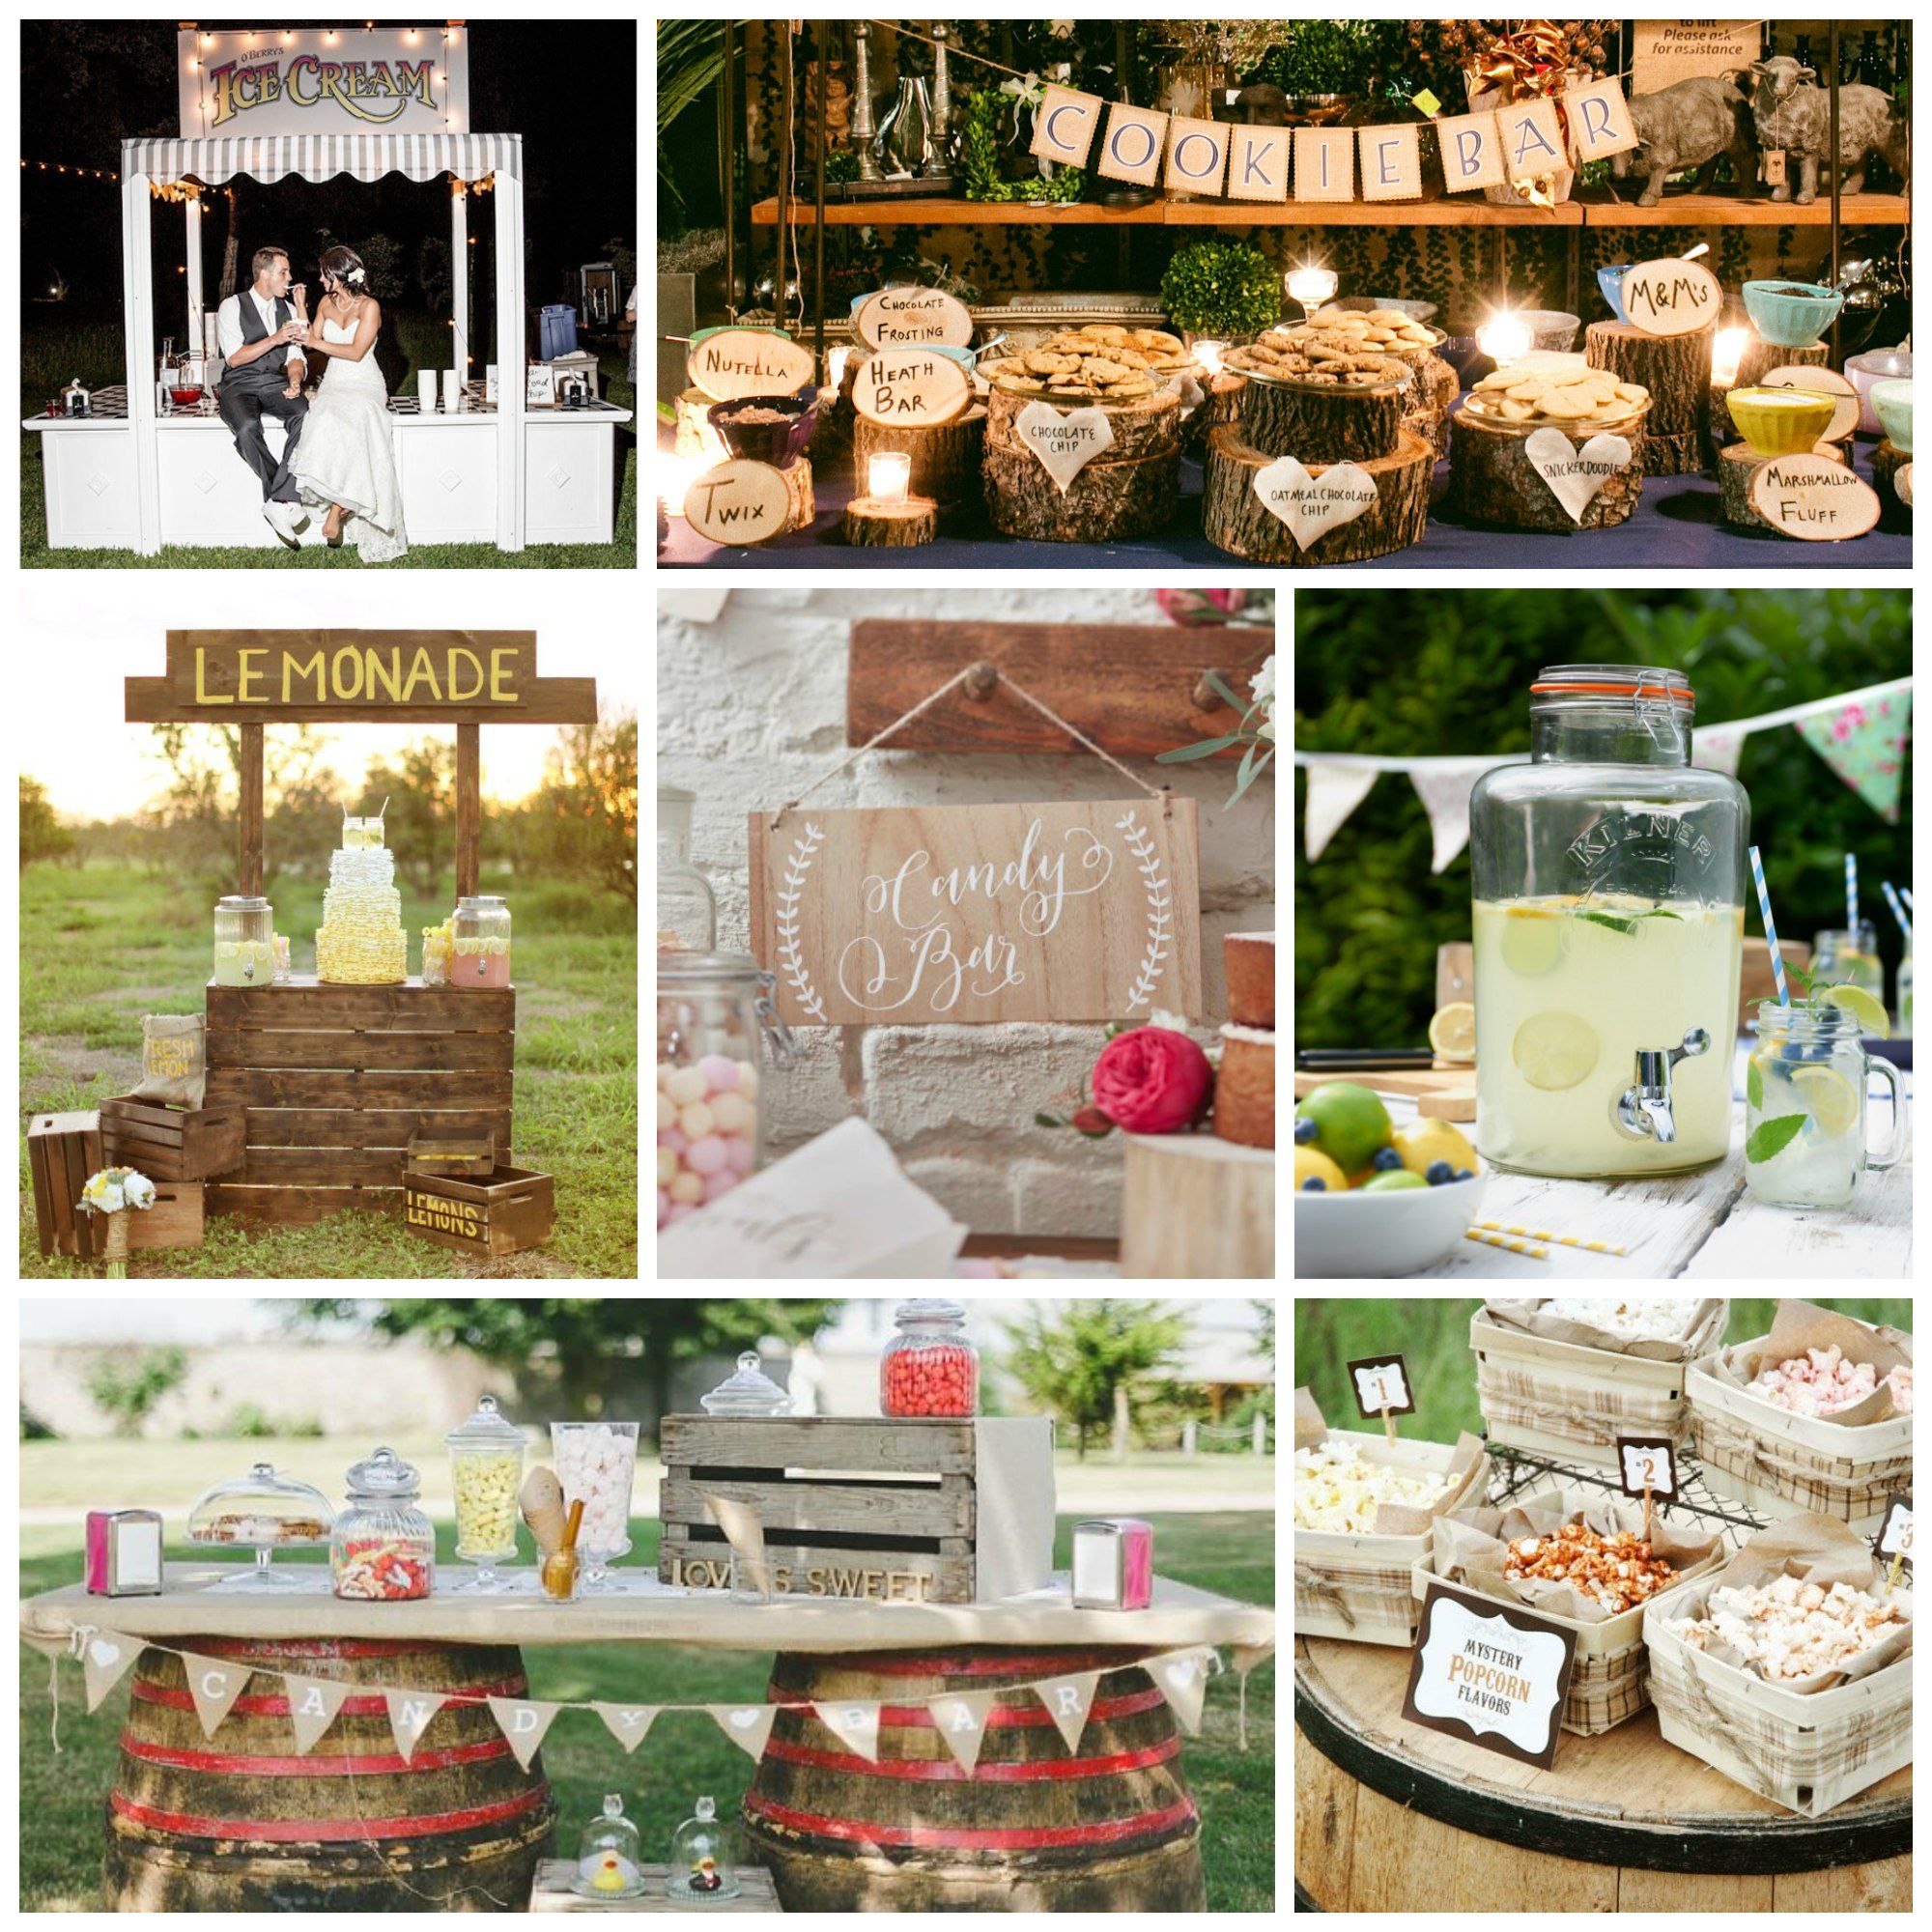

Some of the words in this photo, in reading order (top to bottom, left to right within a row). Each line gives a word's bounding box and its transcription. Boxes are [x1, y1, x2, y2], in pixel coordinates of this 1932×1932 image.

[1653, 43, 1672, 55] for
[1674, 43, 1744, 55] assistance
[1663, 28, 1707, 42] Please
[1709, 28, 1732, 42] ask
[210, 59, 283, 128] ICE
[284, 53, 439, 124] CREAM
[1045, 104, 1402, 188] COOKIE
[1455, 96, 1619, 177] BAR
[879, 296, 945, 310] CHOCOLATE
[877, 323, 945, 342] FROSTING
[705, 349, 788, 379] NUTELLA
[870, 359, 934, 385] HEATH
[874, 385, 927, 414] BAR
[1031, 425, 1096, 440] CHOCOLATE
[1050, 441, 1079, 453] CHIP
[1543, 461, 1623, 478] SNICKERDOODLE
[1766, 466, 1859, 489] MARSHMALLOW
[1270, 488, 1319, 501] OATMEAL
[1320, 488, 1378, 502] CHOCOLATE
[1300, 504, 1330, 516] CHIP
[1780, 500, 1838, 524] FLUFF
[195, 644, 519, 703] LEMONADE
[1567, 814, 1712, 867] KILNER
[862, 817, 1113, 937] Candy
[838, 922, 1026, 1012] Bar
[408, 1189, 479, 1237] LEMONS
[671, 1548, 731, 1589] LOV
[806, 1567, 934, 1603] SWEET
[1463, 1638, 1523, 1671] MYSTERY
[1447, 1654, 1531, 1703] POPCORN
[201, 1671, 645, 1732] CANDY
[844, 1686, 1084, 1732] BAR
[1458, 1685, 1512, 1716] FLAVORS
